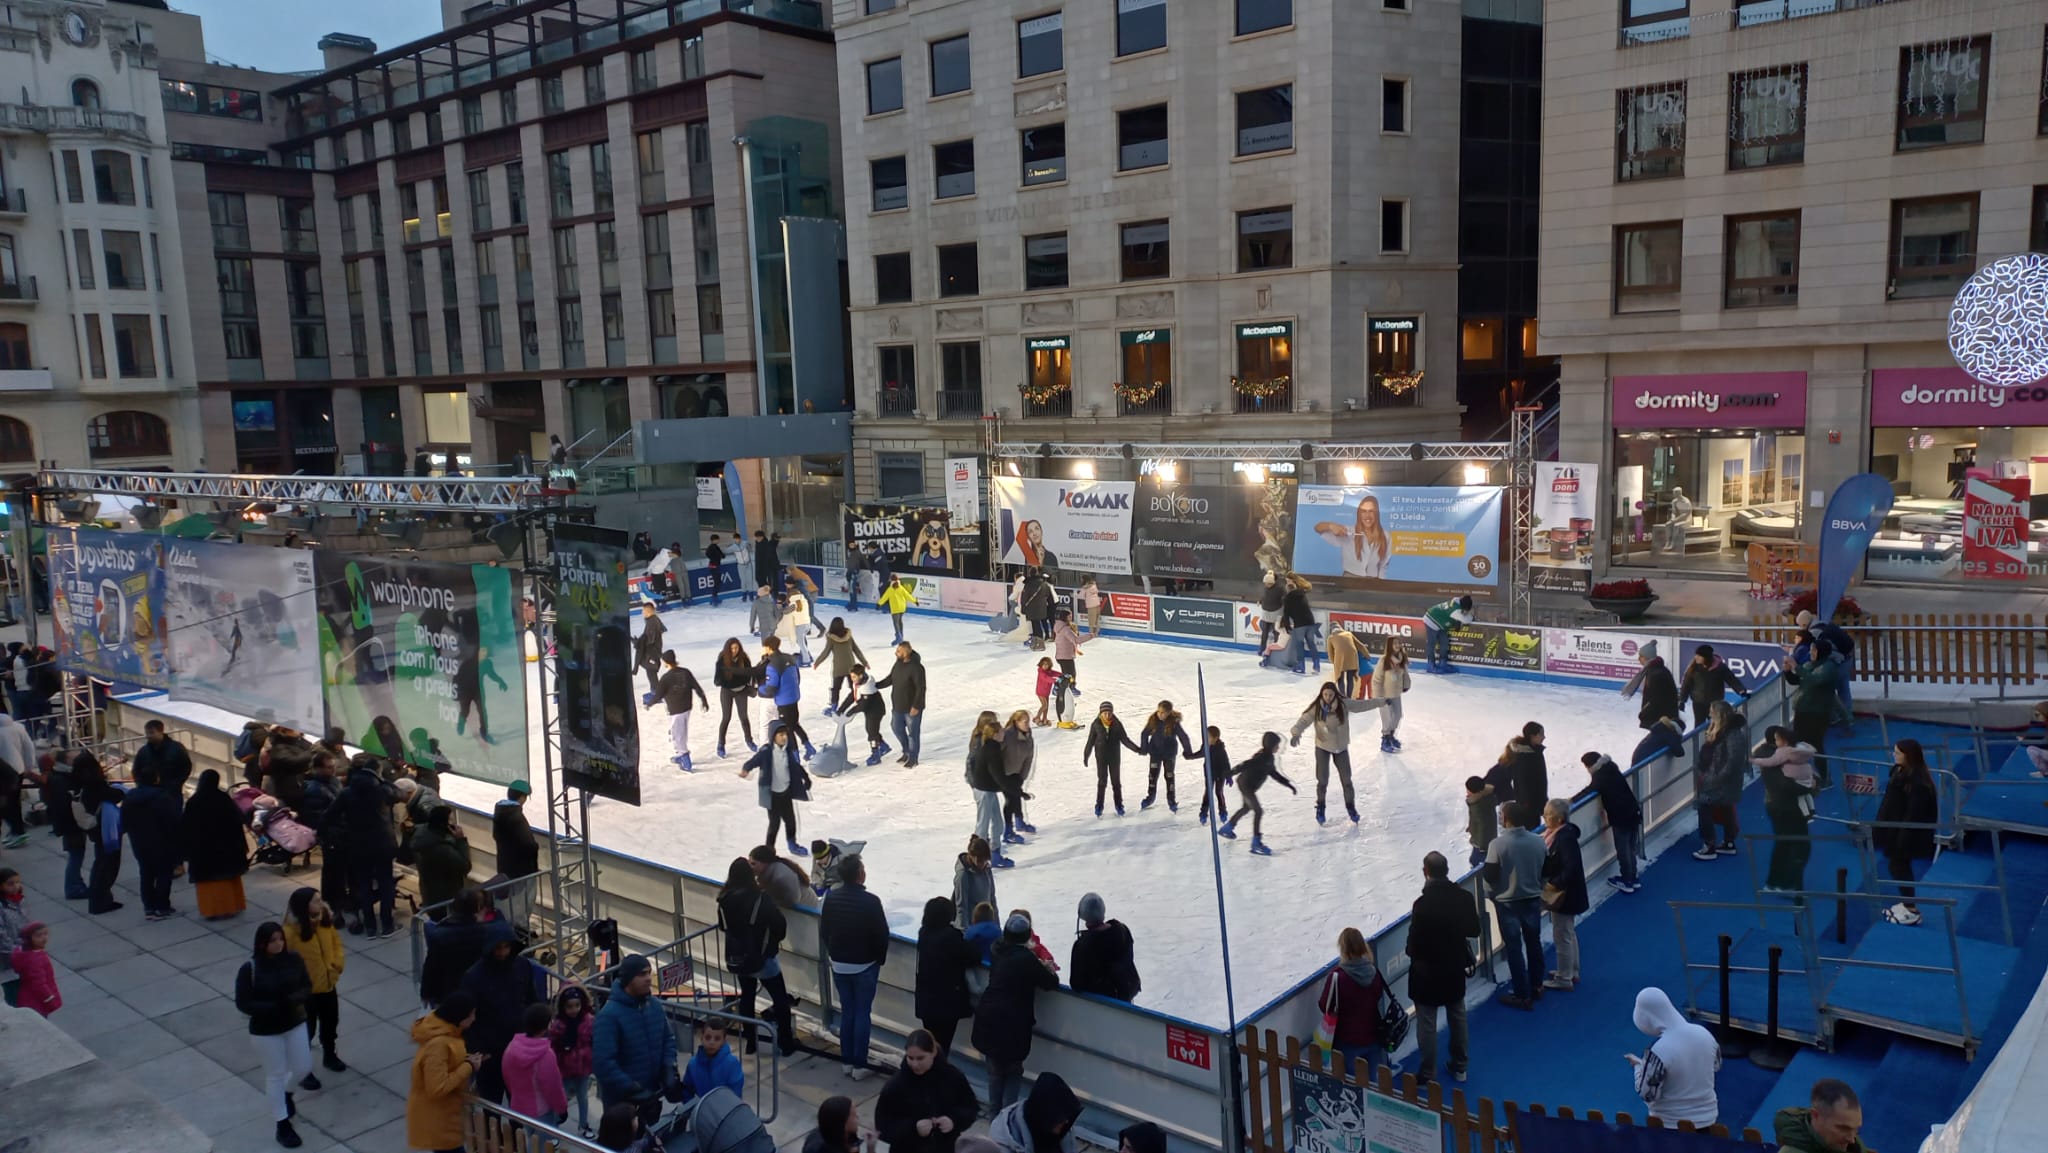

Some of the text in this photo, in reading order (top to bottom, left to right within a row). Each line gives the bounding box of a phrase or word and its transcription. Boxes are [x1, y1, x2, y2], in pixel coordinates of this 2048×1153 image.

[1242, 325, 1286, 336] McDonald's
[1374, 320, 1413, 330] McDonald's
[1030, 339, 1066, 348] McDonald's
[1554, 482, 1577, 492] pont
[1058, 488, 1130, 510] KOMAK
[1151, 491, 1209, 516] BOKOTO
[1972, 503, 2022, 517] NADAL
[853, 518, 905, 537] BONES
[1831, 519, 1866, 531] BBVA
[1980, 515, 2014, 526] SENSE
[1976, 526, 2018, 548] IVA
[1173, 540, 1192, 549] cuina
[1193, 541, 1225, 551] japonesa
[1153, 564, 1203, 574] www.bokoto.es
[1472, 561, 1486, 570] 30
[559, 566, 609, 588] PORTEM
[371, 578, 455, 612] waiphone
[1178, 609, 1225, 620] CUPRA
[1343, 619, 1412, 637] RENTALG
[414, 624, 459, 652] iPhone
[1573, 634, 1613, 650] Talents
[400, 649, 459, 676] com nous
[1728, 658, 1780, 679] BVA
[425, 677, 459, 700] preus
